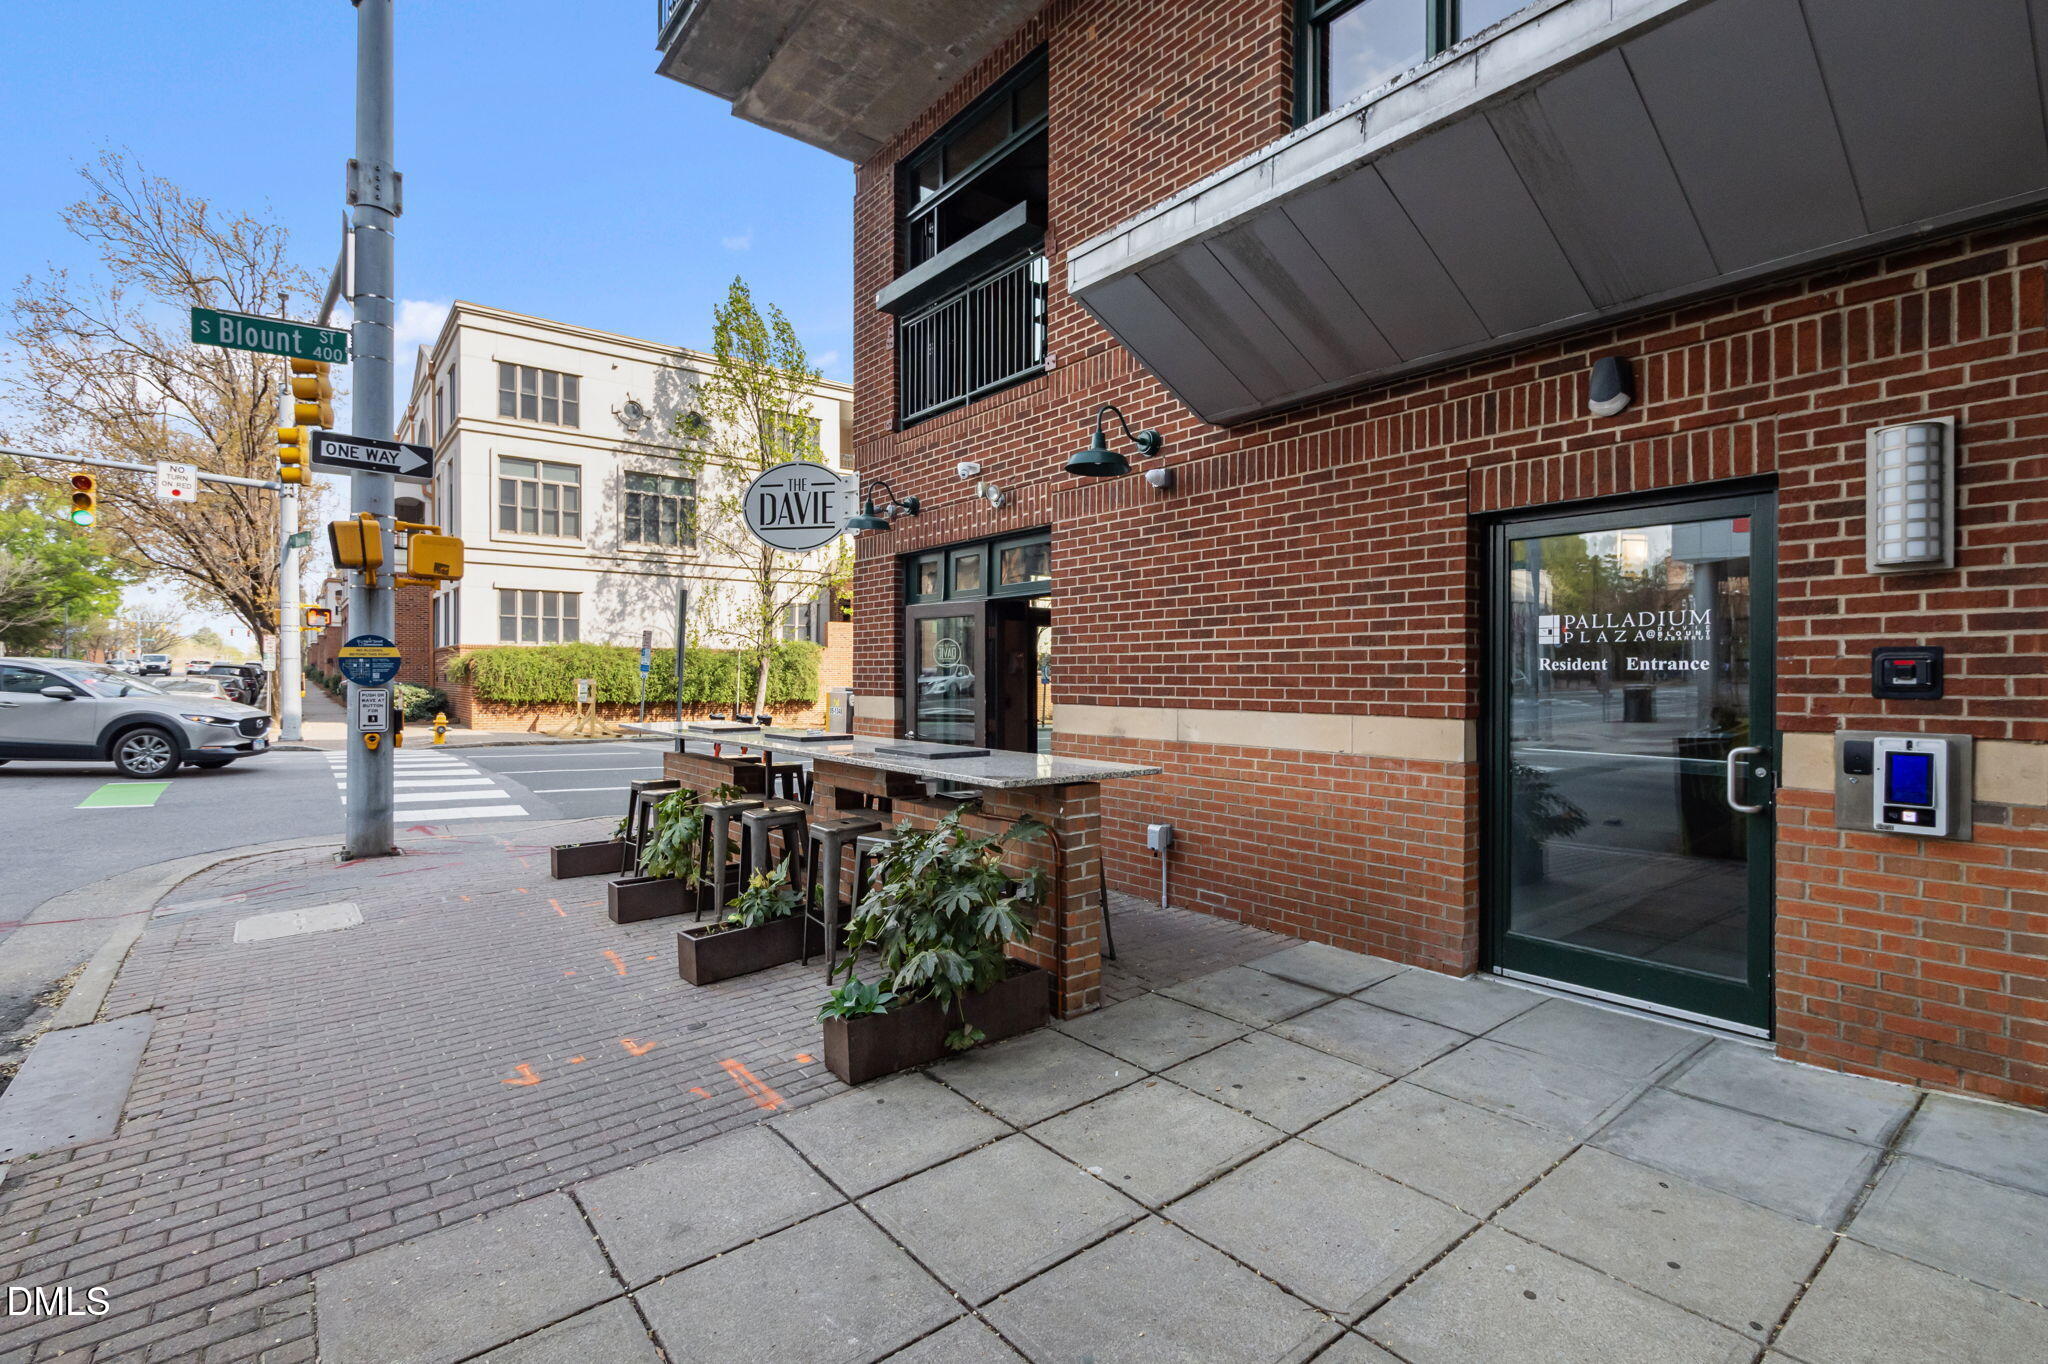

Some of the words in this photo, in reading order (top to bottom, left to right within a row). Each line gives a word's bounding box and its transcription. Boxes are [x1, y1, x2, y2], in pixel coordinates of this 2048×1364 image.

[200, 319, 211, 335] S
[219, 317, 303, 354] Blount
[319, 330, 337, 346] ST
[312, 346, 343, 363] 400
[325, 443, 360, 461] ONE
[366, 448, 400, 465] WAY
[169, 465, 185, 474] NO
[166, 473, 189, 482] TURN
[788, 478, 808, 492] THE
[759, 490, 836, 526] DAVIE
[1564, 608, 1712, 630] PALLADIUM
[1564, 630, 1646, 645] PLAZA
[1538, 657, 1608, 671] Resident
[1626, 656, 1711, 671] Entrance
